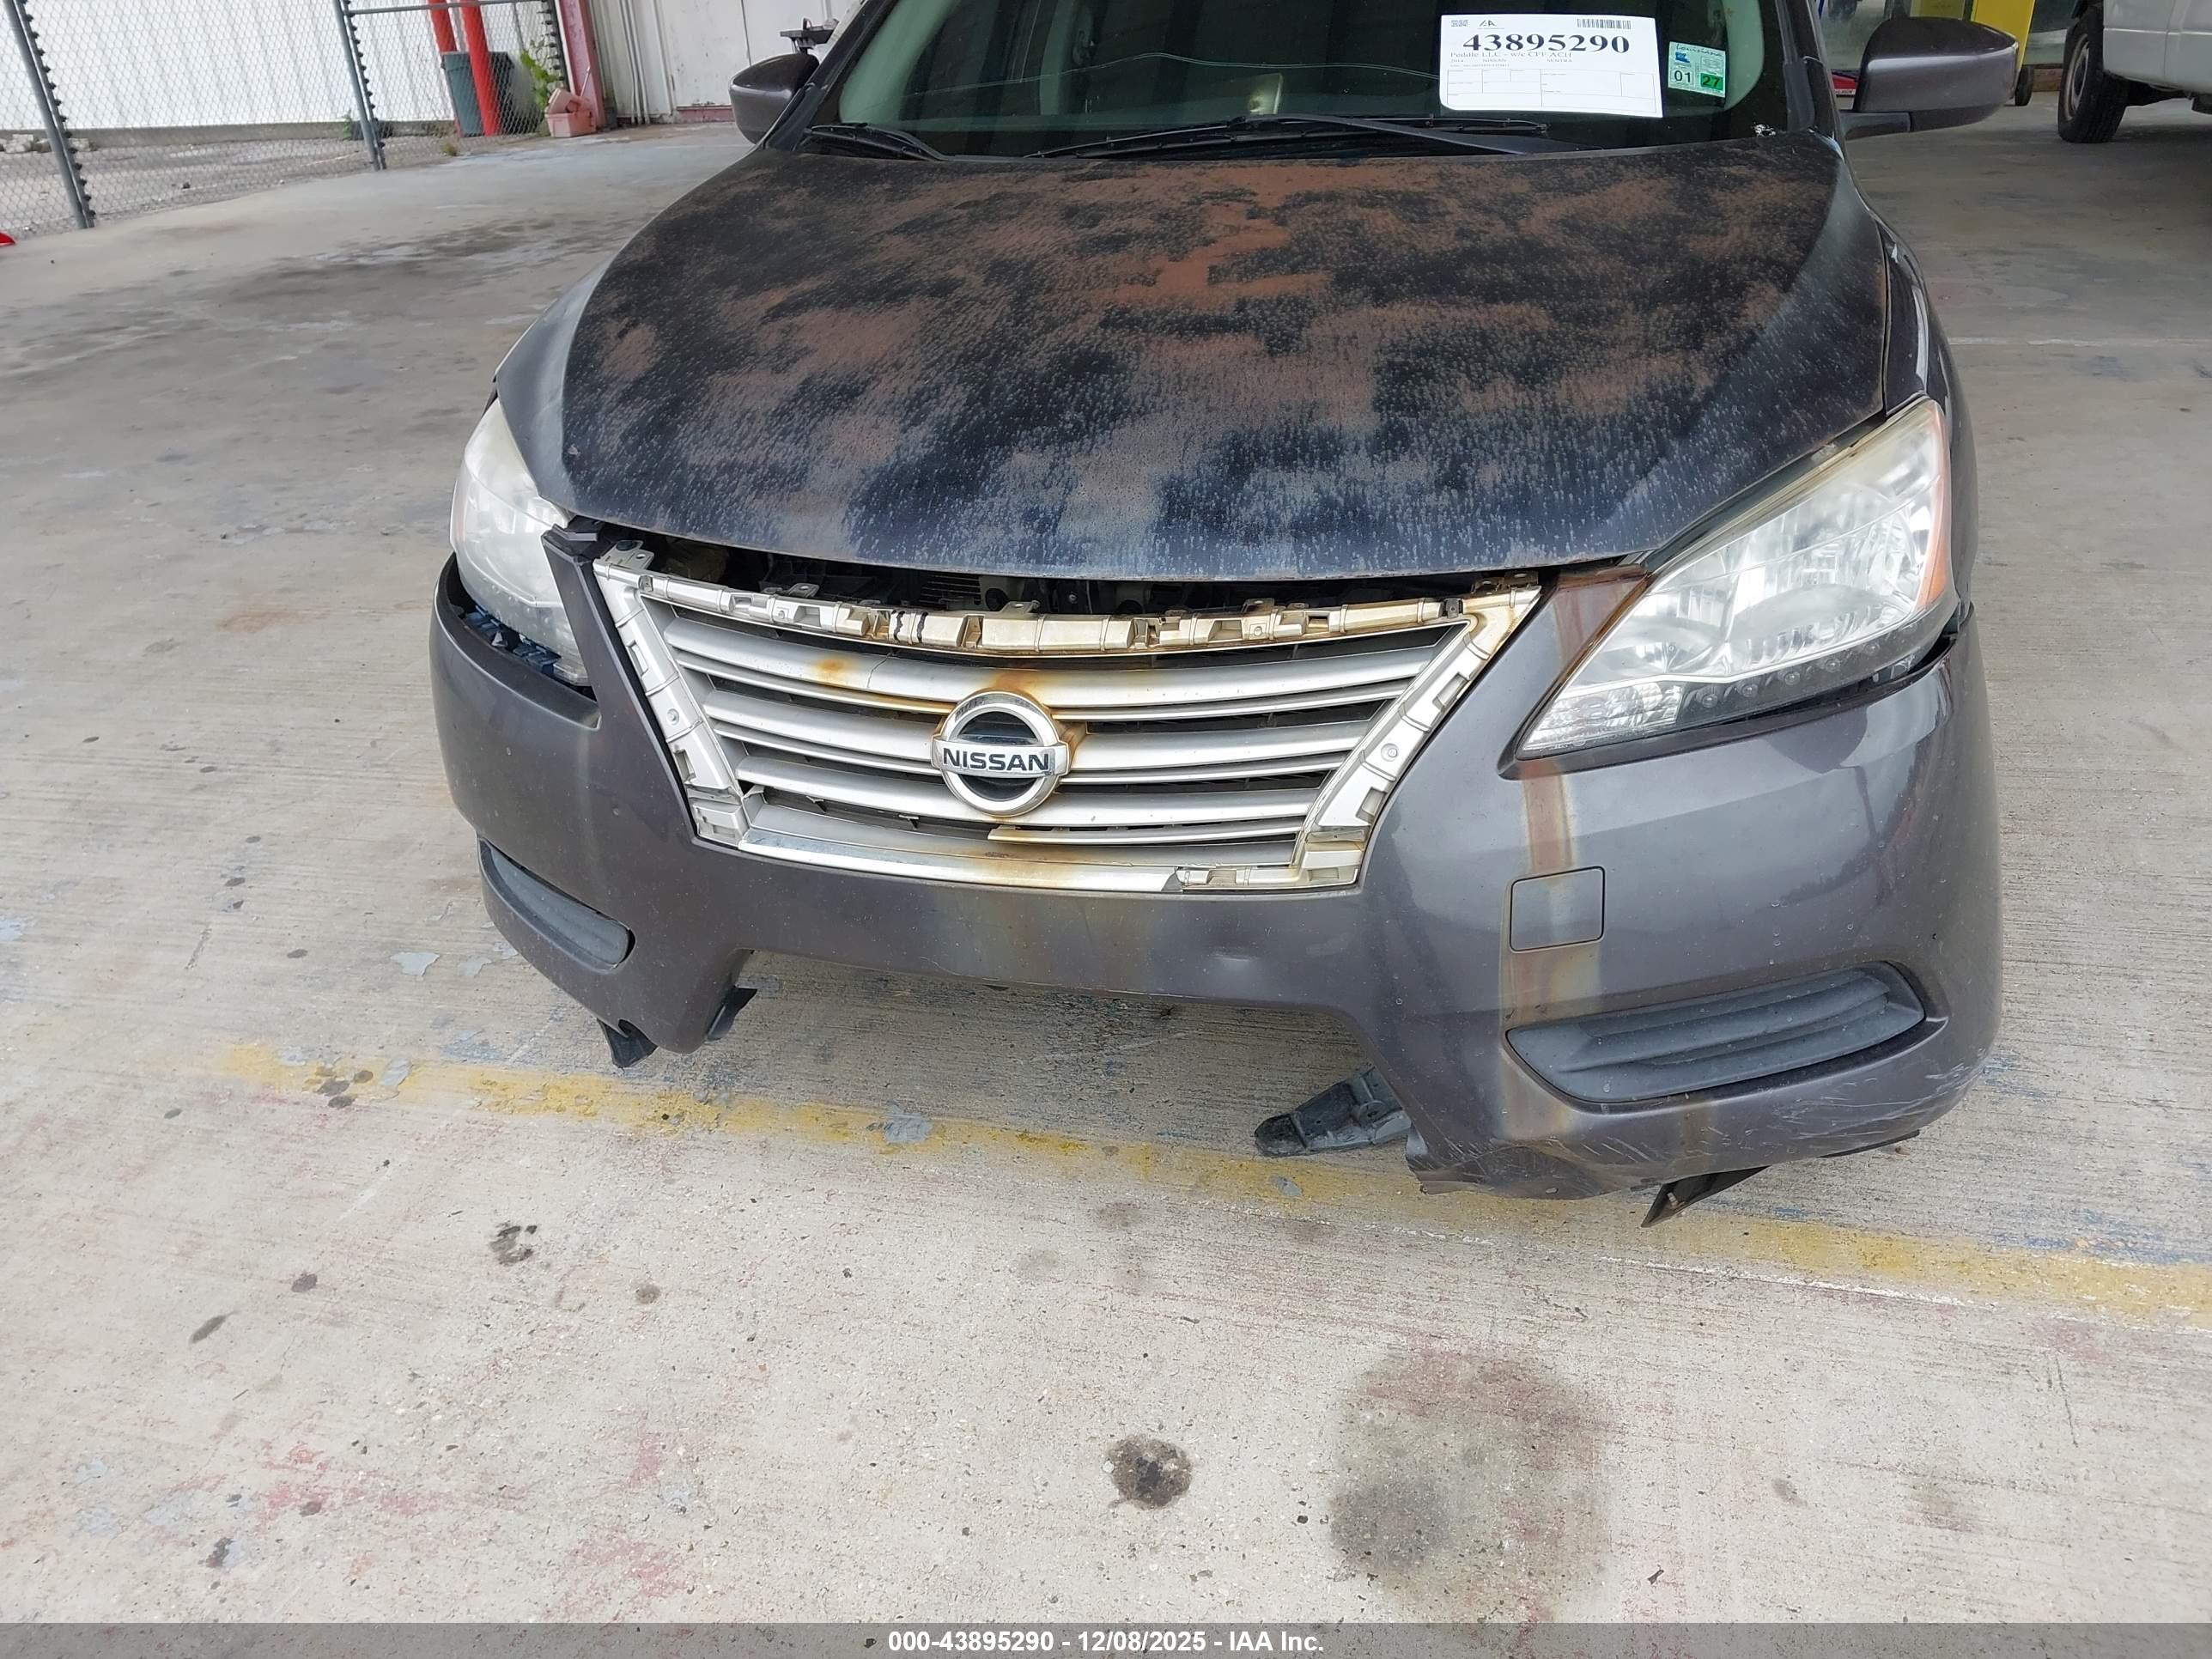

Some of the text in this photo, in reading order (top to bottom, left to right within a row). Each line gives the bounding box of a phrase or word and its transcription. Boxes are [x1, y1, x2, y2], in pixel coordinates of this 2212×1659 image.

[1462, 33, 1630, 53] 43895290
[1674, 70, 1691, 83] 01
[1703, 75, 1721, 88] 27
[943, 747, 1050, 772] NISSAN
